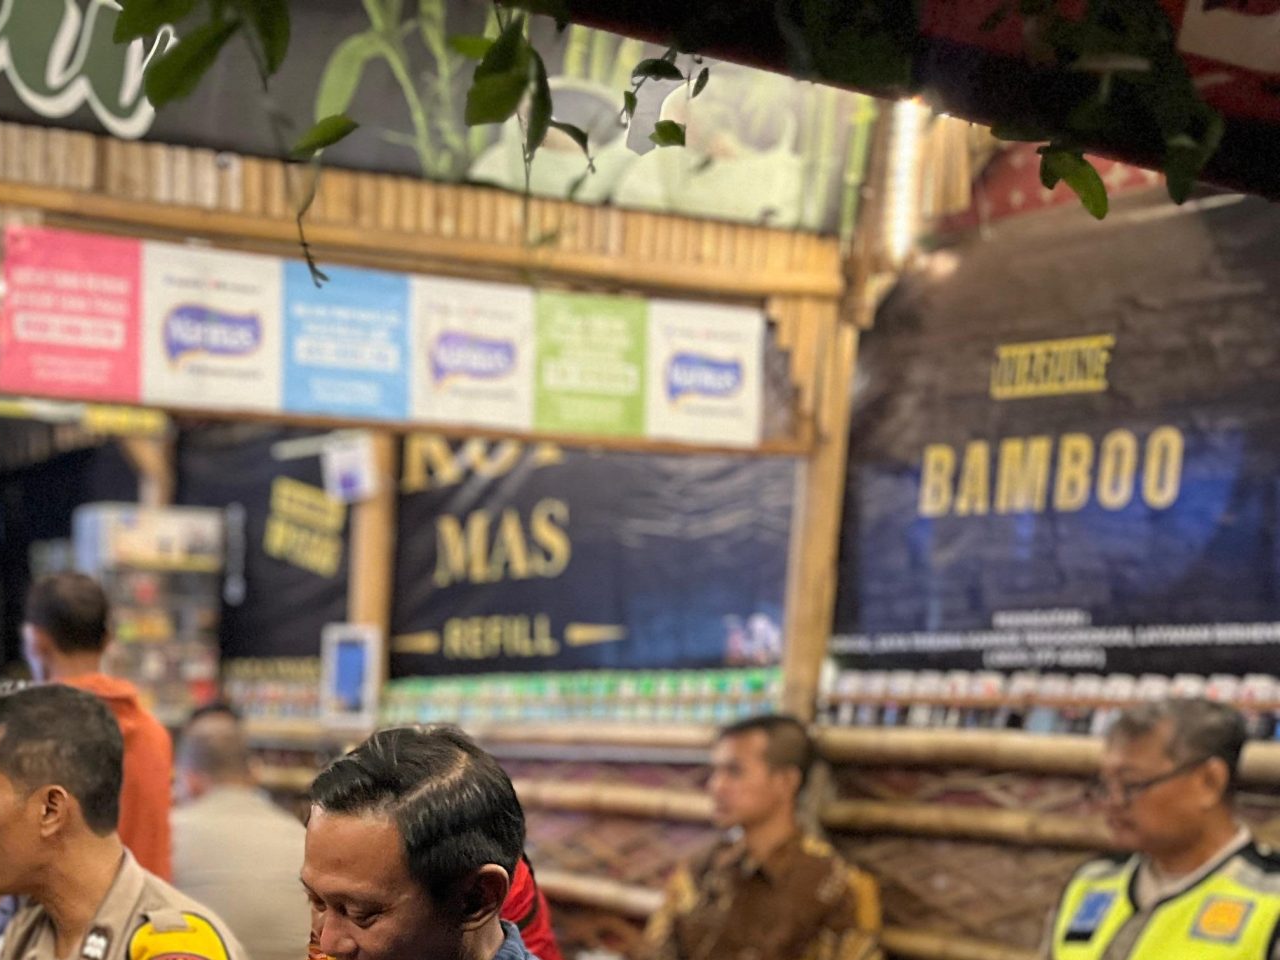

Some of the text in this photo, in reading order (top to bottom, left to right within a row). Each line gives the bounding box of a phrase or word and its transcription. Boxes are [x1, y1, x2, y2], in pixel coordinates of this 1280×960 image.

[918, 424, 1186, 518] BAMBOO
[433, 497, 571, 588] MAS
[442, 614, 560, 662] REFILL
